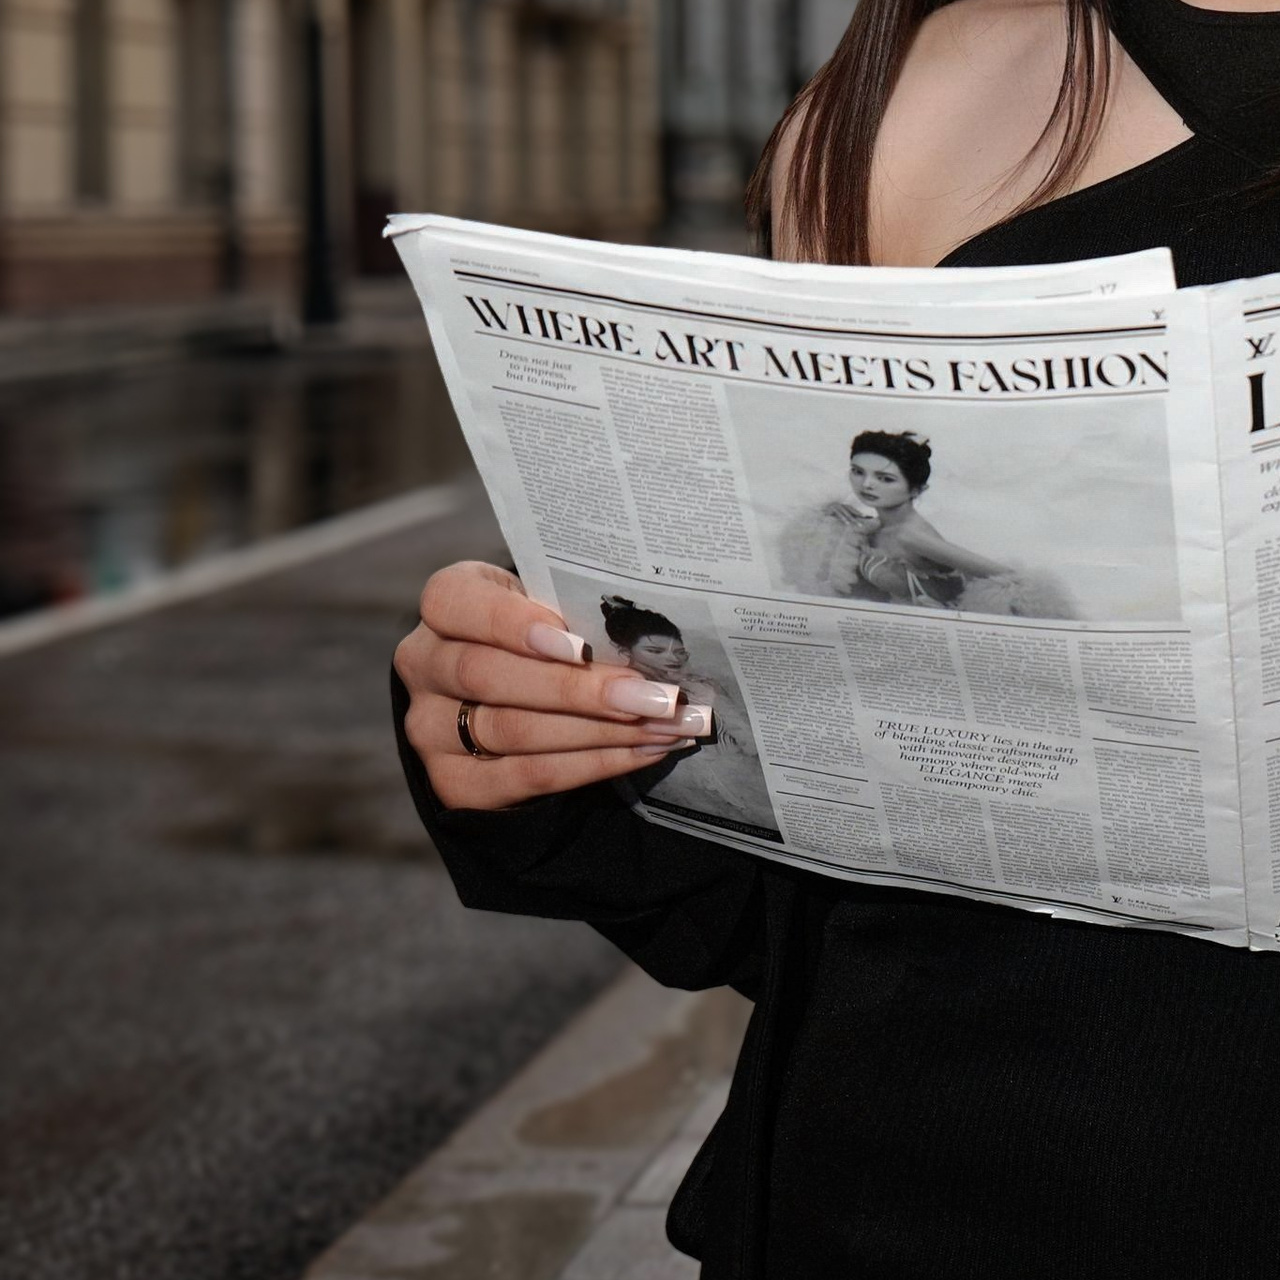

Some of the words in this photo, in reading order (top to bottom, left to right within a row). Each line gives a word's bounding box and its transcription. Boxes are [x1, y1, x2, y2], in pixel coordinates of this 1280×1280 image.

[464, 295, 641, 356] WHERE
[655, 329, 744, 371] ART
[764, 346, 934, 392] MEETS
[948, 350, 1169, 392] FASHION
[499, 349, 528, 365] Dress
[532, 358, 549, 369] not
[552, 360, 572, 372] just
[509, 363, 520, 371] to
[506, 371, 524, 381] but
[527, 376, 538, 384] to
[540, 377, 578, 393] inspire
[734, 606, 771, 619] Classic
[773, 611, 809, 623] charm
[740, 615, 765, 626] with
[774, 620, 808, 630] touch
[743, 623, 755, 632] of
[759, 625, 812, 637] tomorrow
[874, 729, 887, 740] of
[892, 731, 946, 748] blending
[949, 739, 988, 752] classic
[990, 746, 1079, 766] craftsmanship
[876, 720, 919, 733] TRUE
[924, 726, 991, 742] LUXURY
[993, 735, 1013, 746] lies
[1017, 739, 1029, 747] in
[1033, 741, 1052, 751] the
[1055, 745, 1075, 754] art
[899, 742, 927, 754] with
[930, 746, 995, 763] innovative
[997, 756, 1045, 771] designs,
[1049, 763, 1058, 771] a
[899, 752, 957, 770] harmony
[960, 761, 1000, 771] where
[999, 766, 1060, 781] old-world
[919, 764, 1006, 784] ELEGANCE
[1008, 777, 1044, 789] meets
[923, 774, 1009, 795] contemporary
[1011, 787, 1040, 799] chic.
